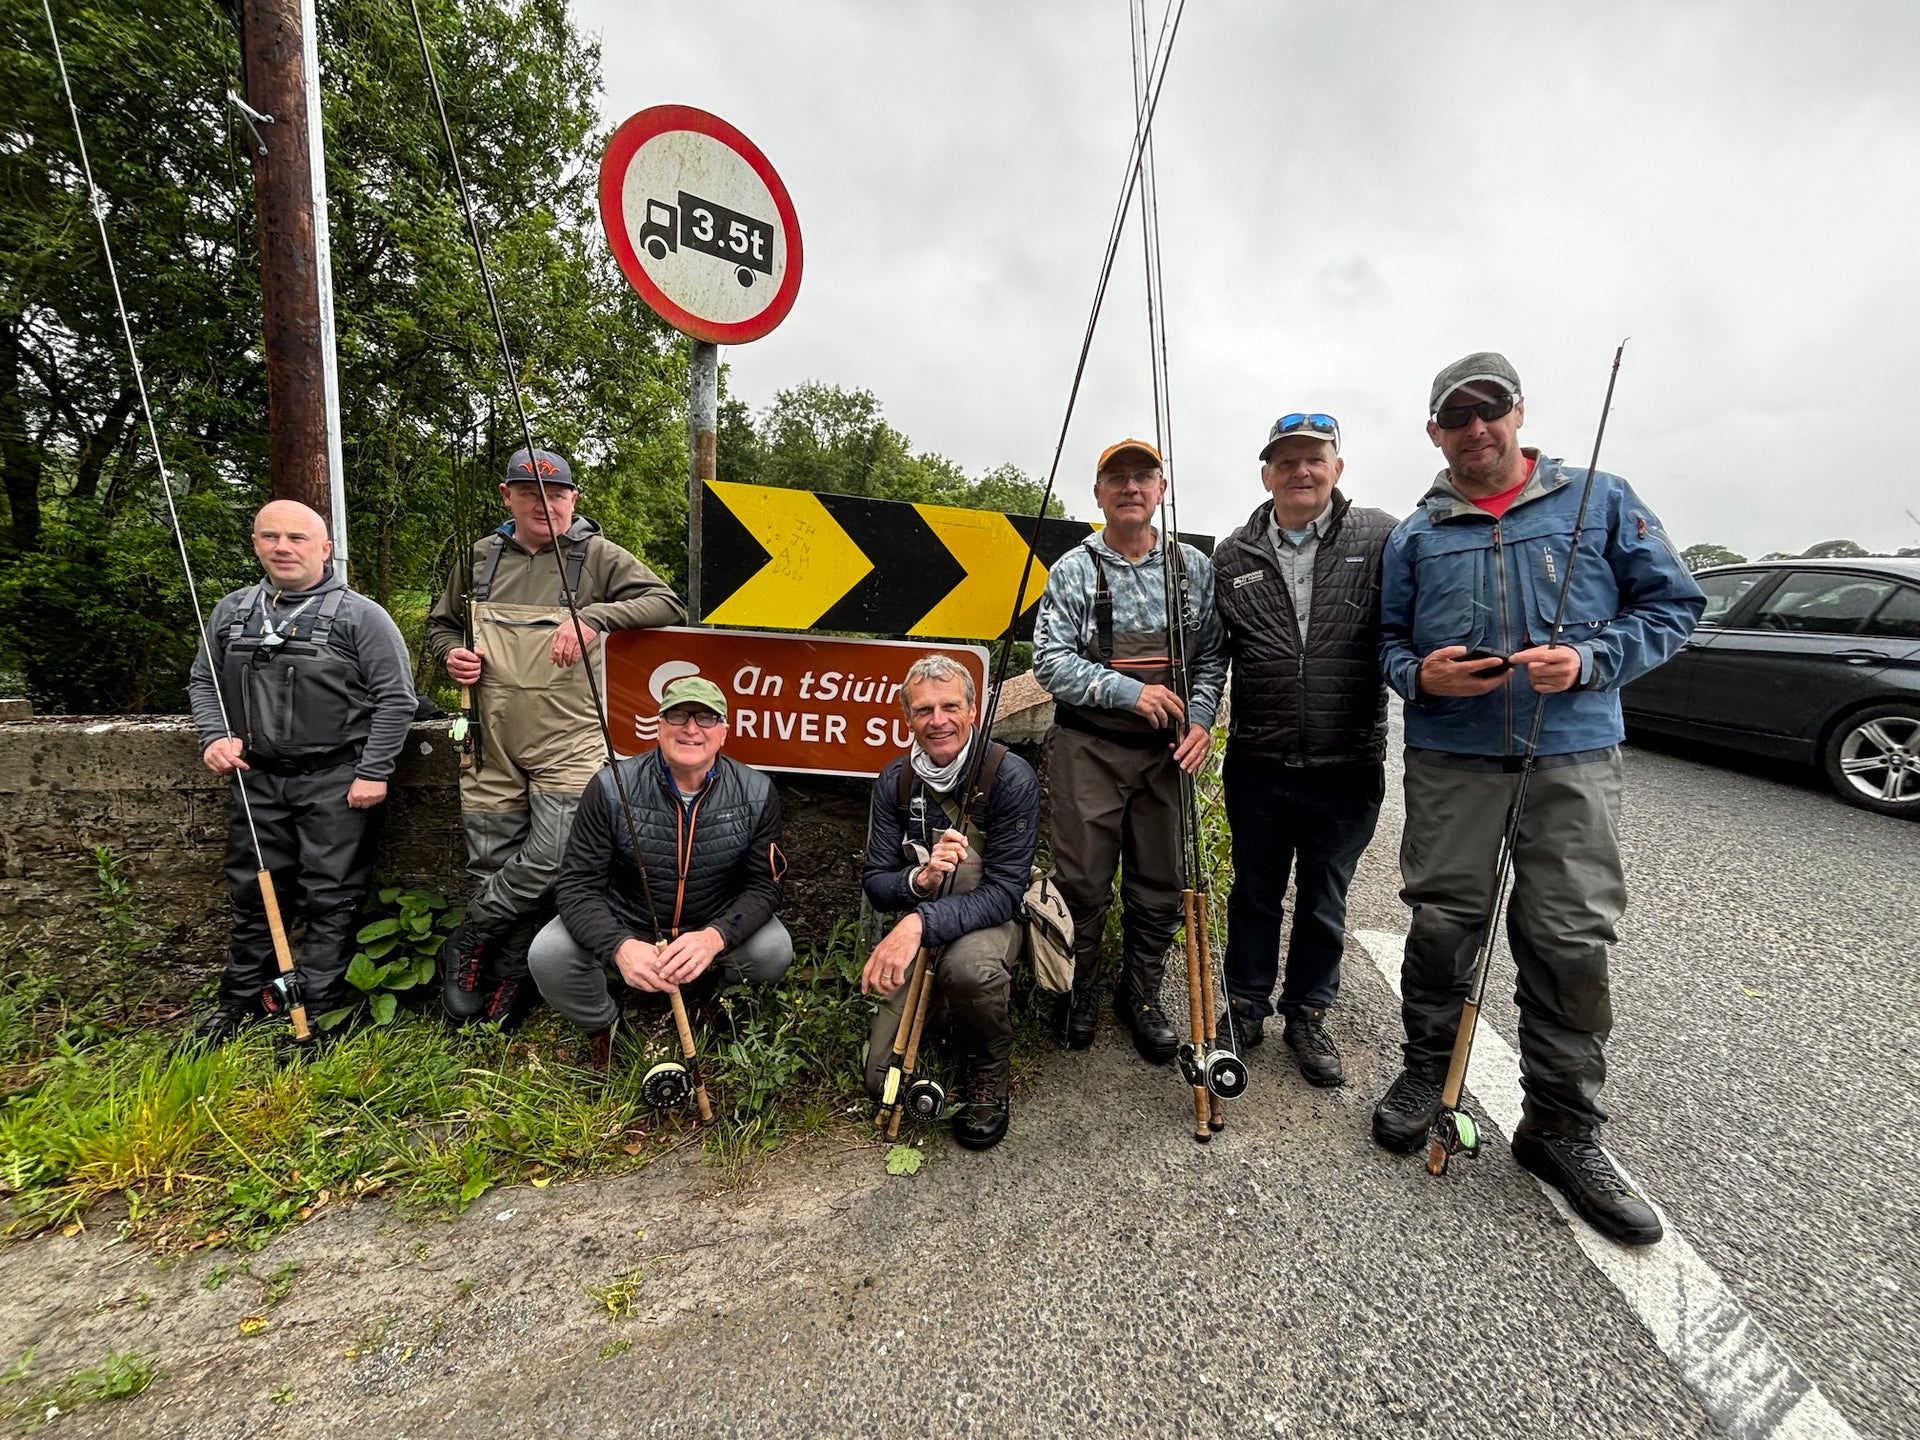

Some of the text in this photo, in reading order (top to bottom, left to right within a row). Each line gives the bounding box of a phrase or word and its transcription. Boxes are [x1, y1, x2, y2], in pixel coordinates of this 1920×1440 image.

[692, 208, 764, 261] 3.5t
[735, 708, 915, 748] RIVER SU
